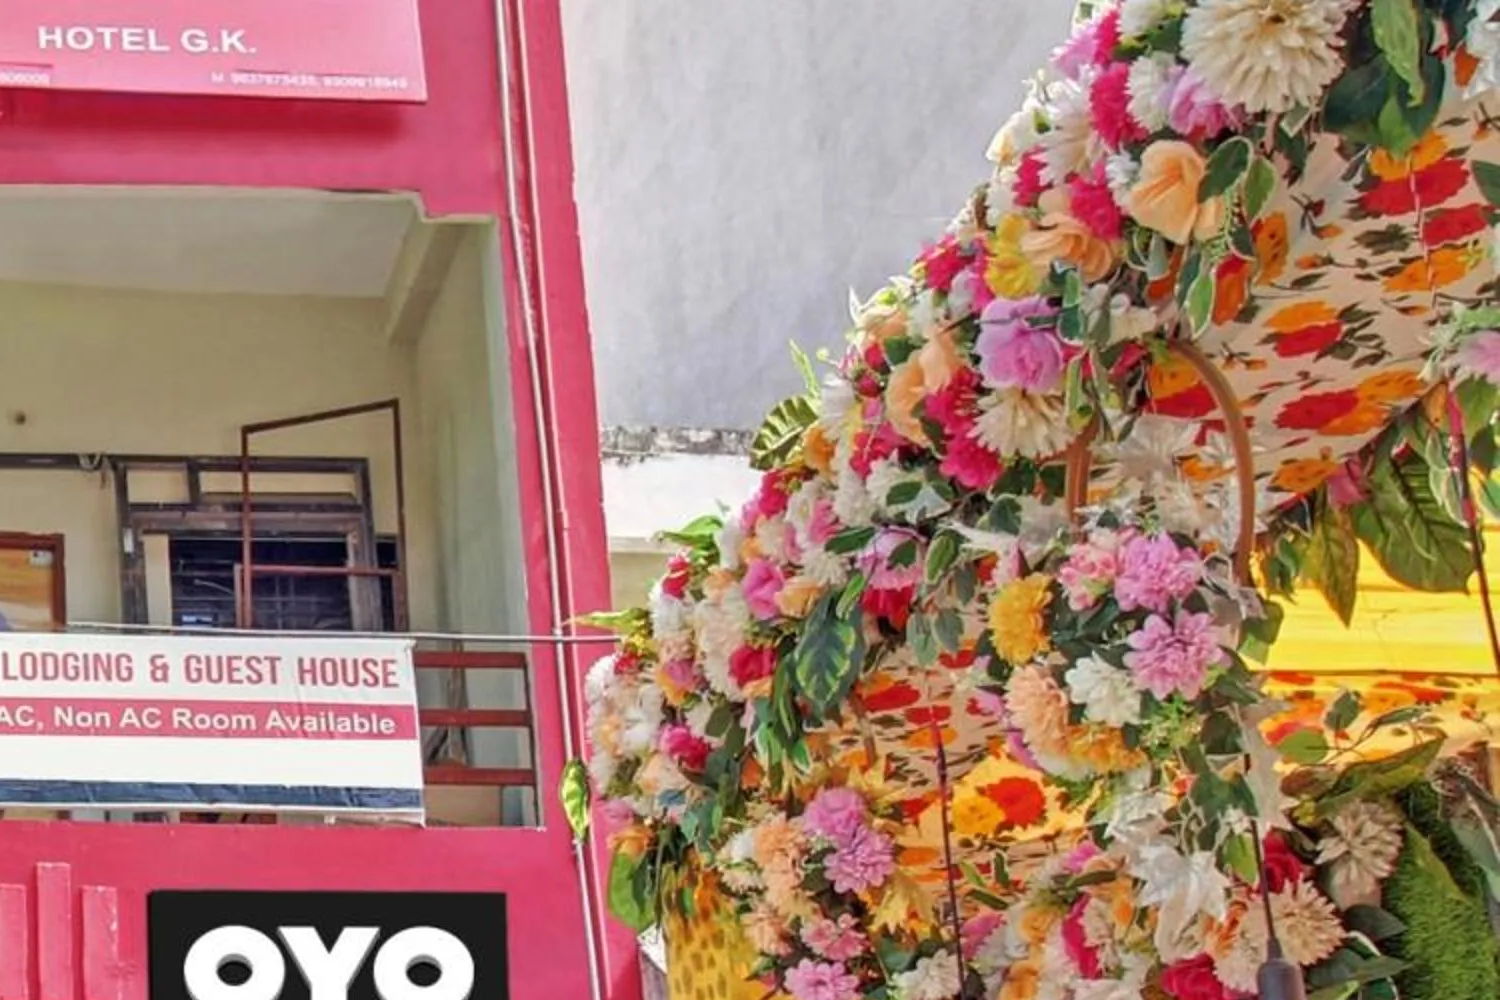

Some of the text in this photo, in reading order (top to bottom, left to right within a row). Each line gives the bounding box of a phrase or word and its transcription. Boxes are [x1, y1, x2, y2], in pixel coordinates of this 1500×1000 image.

[38, 26, 257, 54] HOTEL G.K.
[1, 651, 399, 689] LODGING & GUEST HOUSE
[54, 707, 110, 728] Non
[120, 708, 162, 728] AC
[173, 709, 256, 732] Room
[265, 710, 395, 735] Available
